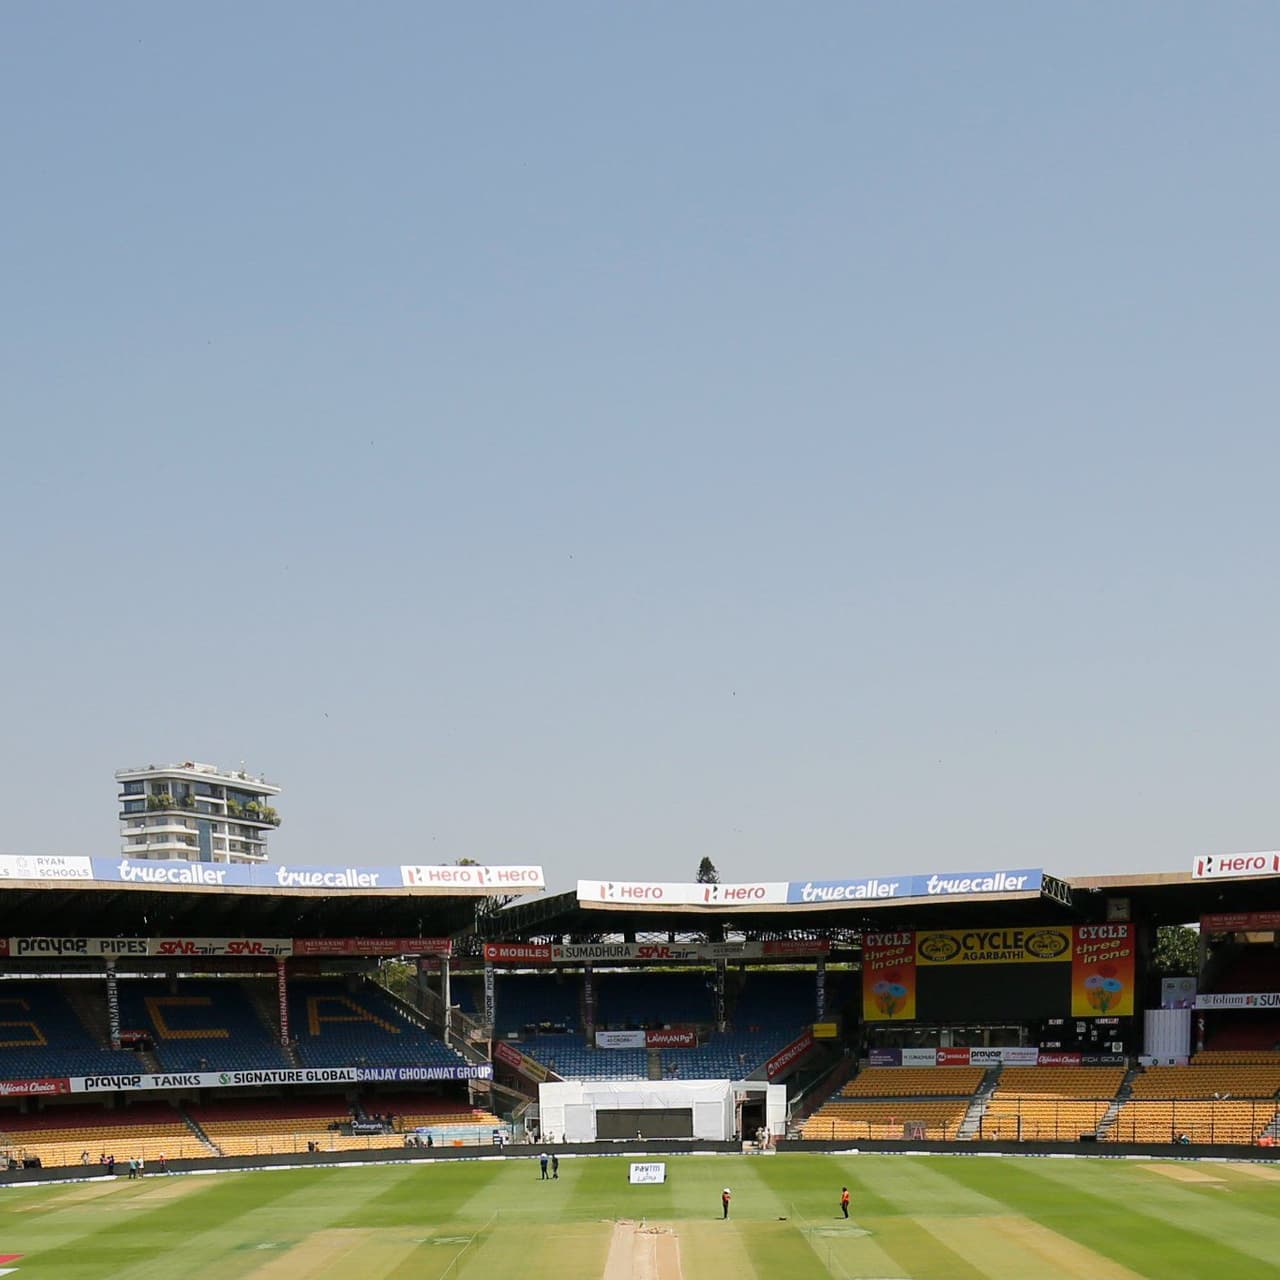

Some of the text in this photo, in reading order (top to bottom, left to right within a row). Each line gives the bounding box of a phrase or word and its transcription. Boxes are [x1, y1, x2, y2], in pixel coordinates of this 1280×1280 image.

[37, 857, 66, 866] RYAN
[1219, 854, 1266, 871] Hero
[40, 868, 89, 878] SCHOOLS
[117, 860, 227, 886] truecaller
[276, 866, 380, 888] truecaller
[428, 870, 472, 884] Hero
[497, 870, 538, 884] Hero
[926, 873, 1028, 894] truecaller
[621, 885, 663, 900] Hero
[724, 885, 766, 900] Hero
[800, 880, 899, 902] truecaller
[1078, 926, 1128, 939] CYCLE
[17, 939, 147, 954] prayag PIPES
[866, 933, 912, 947] CYCLE
[962, 931, 1024, 950] CYCLE
[157, 942, 196, 955] STAR
[224, 942, 262, 955] STAR
[500, 947, 550, 958] MOBILES
[567, 946, 631, 958] SUMADHURA
[636, 946, 669, 959] STAR
[864, 947, 905, 961] three
[1076, 940, 1121, 955] three
[886, 956, 913, 967] one
[962, 951, 1024, 962] AGARBATHI
[1100, 949, 1131, 961] one
[234, 1069, 354, 1083] SIGNATURE GLOBAL
[357, 1066, 492, 1081] SANJAY GHODAWAT GROUP
[31, 1082, 56, 1093] Choice
[85, 1075, 200, 1090] prayag TANKS
